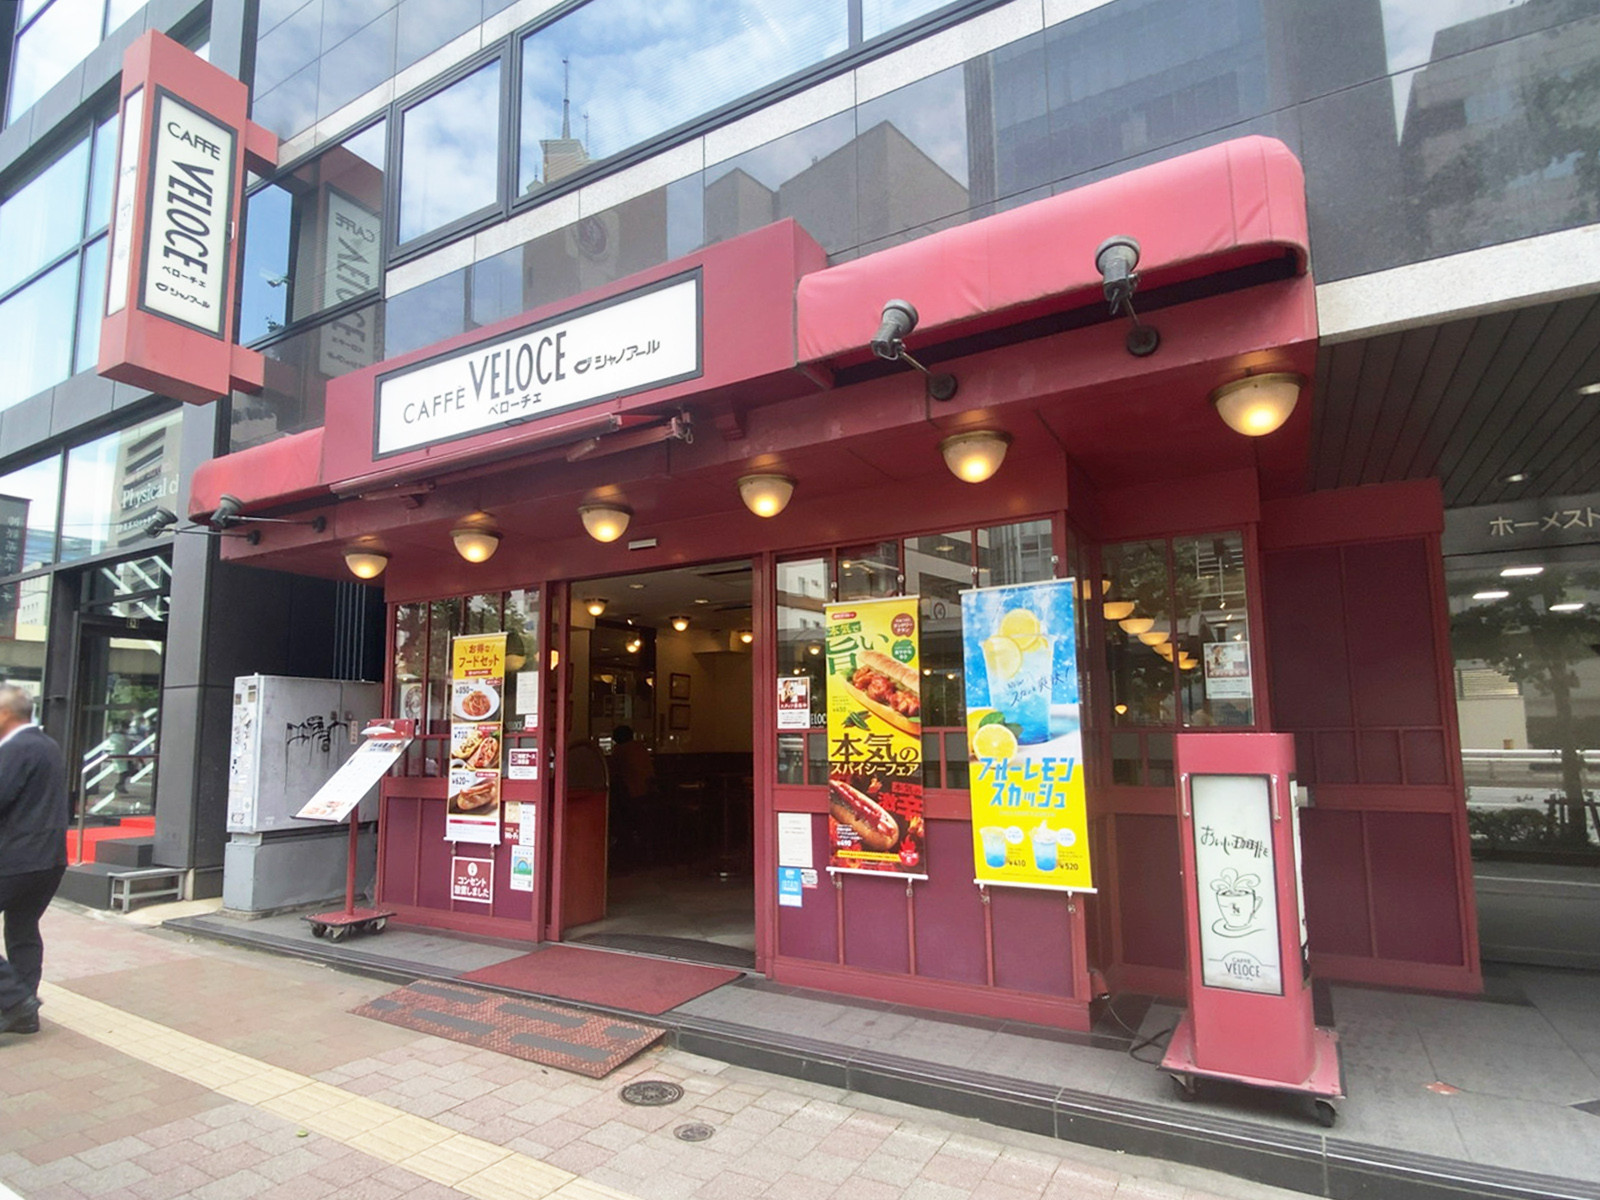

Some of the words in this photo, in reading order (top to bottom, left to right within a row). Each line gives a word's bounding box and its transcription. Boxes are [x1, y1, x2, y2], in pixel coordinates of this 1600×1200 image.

[167, 121, 221, 161] CAFFE
[163, 160, 215, 275] VELOCE
[469, 331, 567, 400] VELOCE
[594, 339, 661, 370] シャノアール
[488, 392, 542, 416] ベローチェ
[121, 477, 167, 509] Physical
[1489, 507, 1600, 536] ホーメスト
[458, 654, 500, 668] フードセット
[831, 733, 919, 762] 本気の
[831, 762, 919, 776] スパイシーフェア
[990, 782, 1066, 808] スカッシュ
[457, 876, 487, 888] コンセント
[1225, 961, 1260, 978] VELOCE
